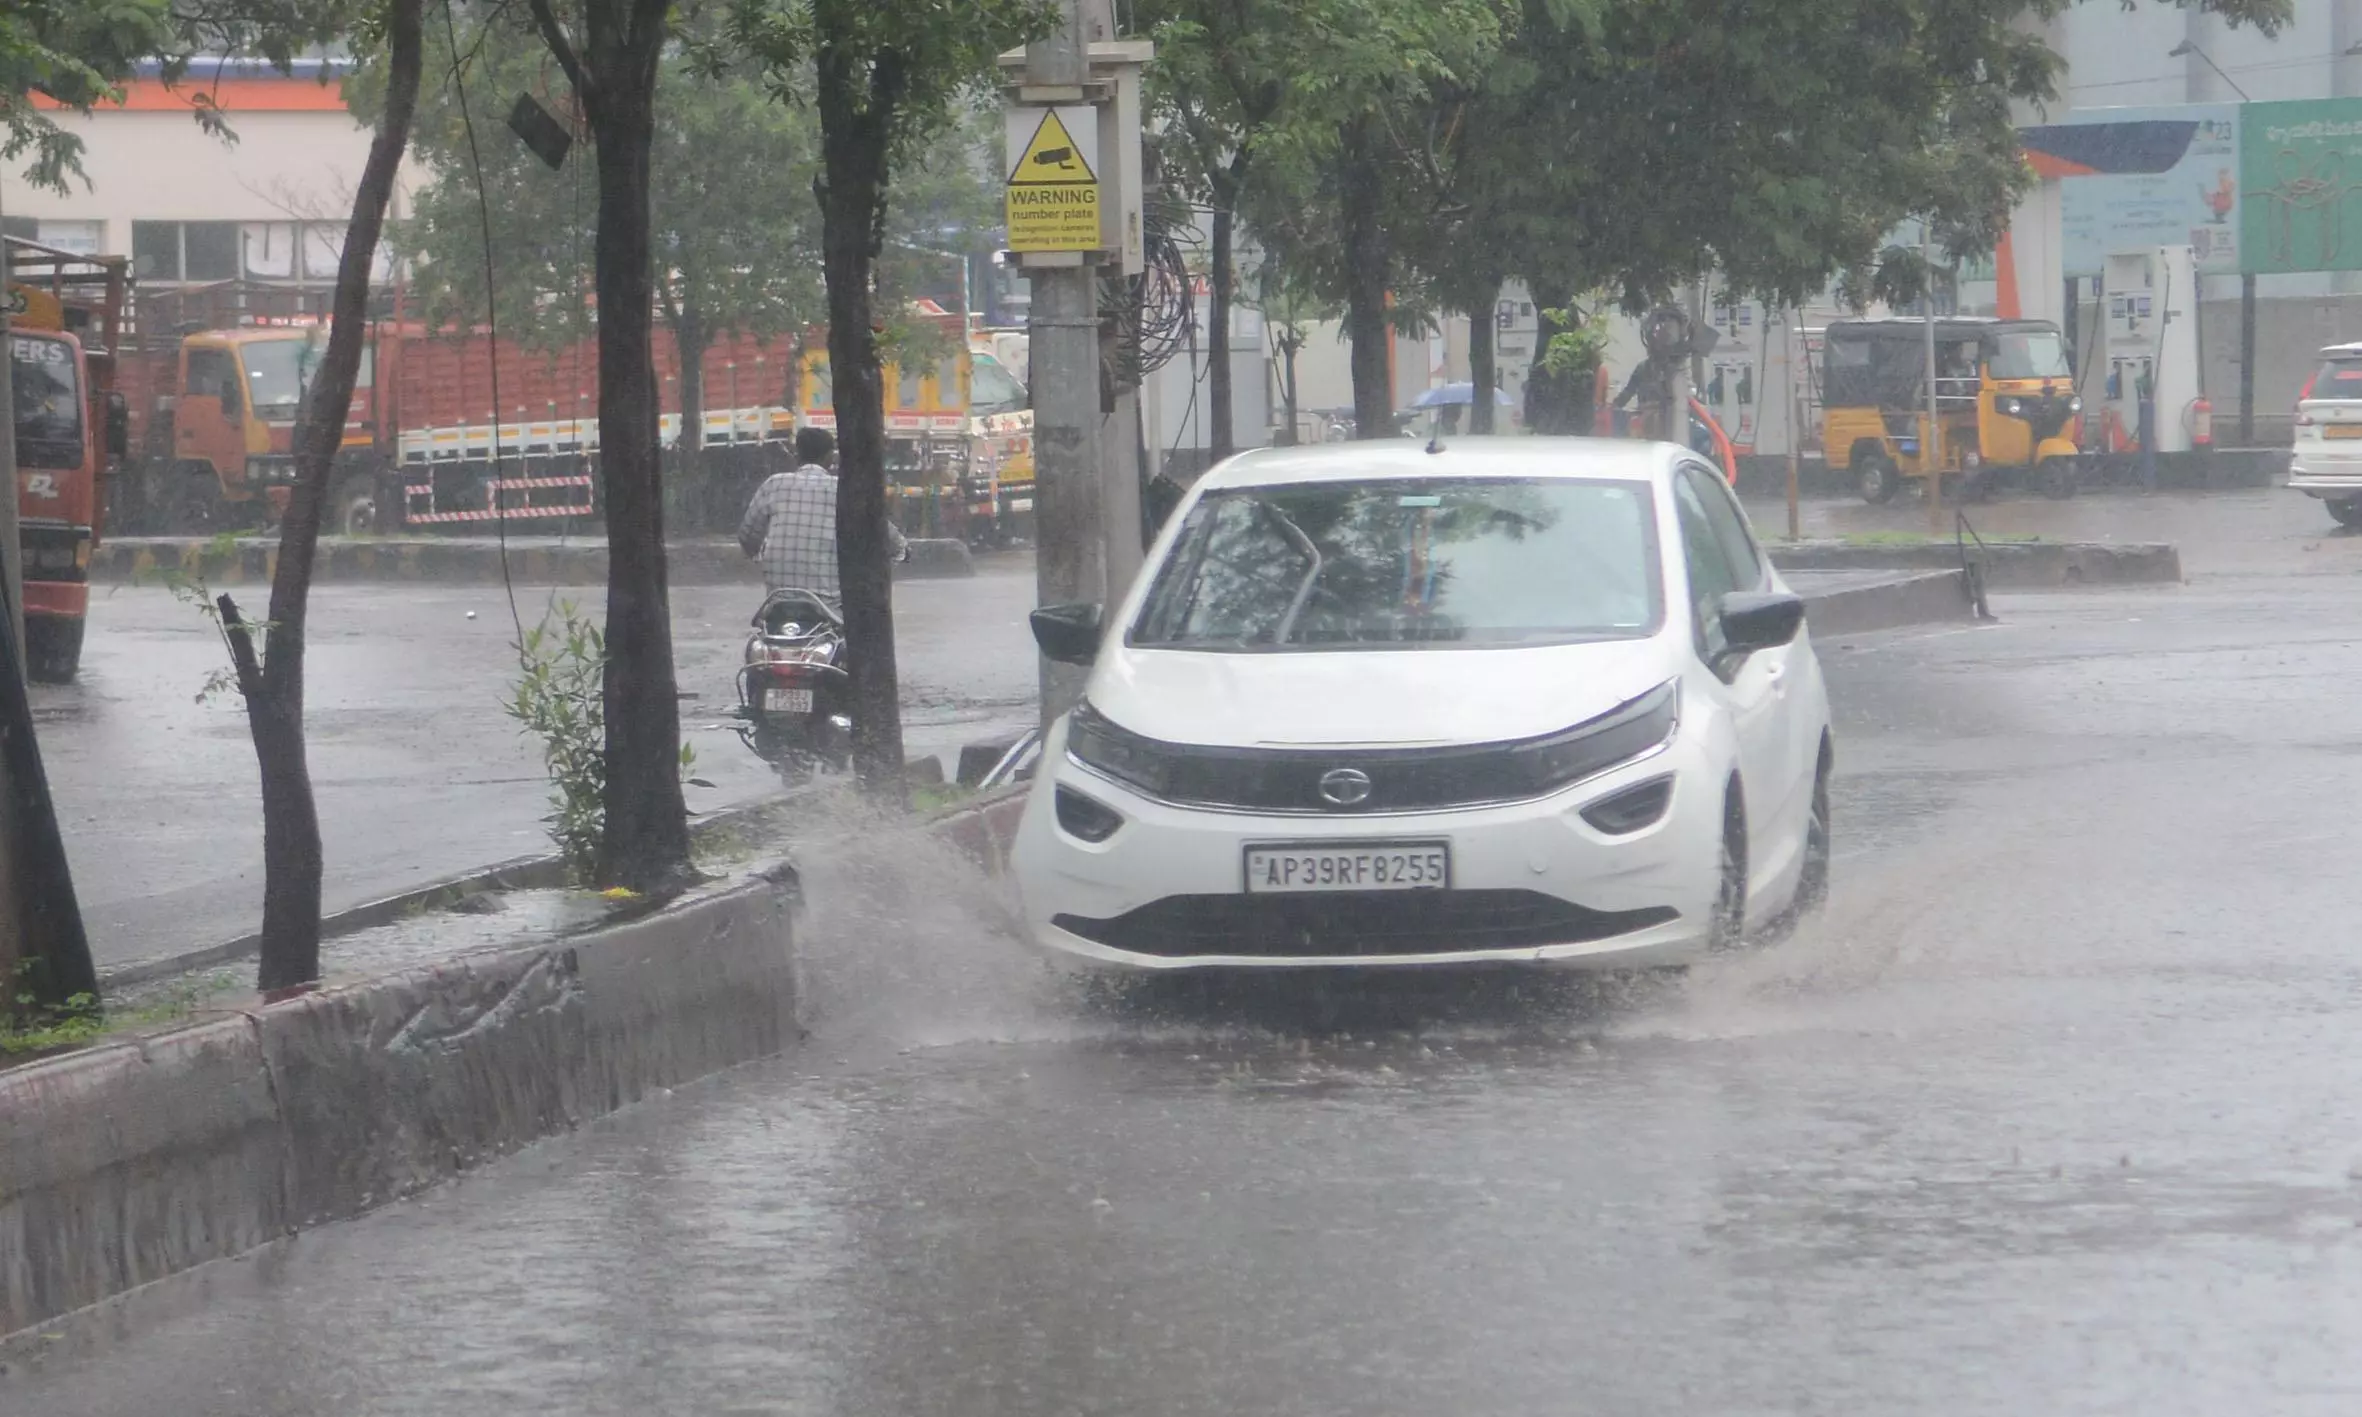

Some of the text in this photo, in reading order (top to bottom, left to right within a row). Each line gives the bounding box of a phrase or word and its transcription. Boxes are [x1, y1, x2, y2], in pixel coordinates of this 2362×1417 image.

[1011, 189, 1096, 205] WARNING
[1012, 207, 1094, 221] number plate
[12, 339, 65, 363] ERS
[1267, 855, 1443, 885] AP39RF8255
